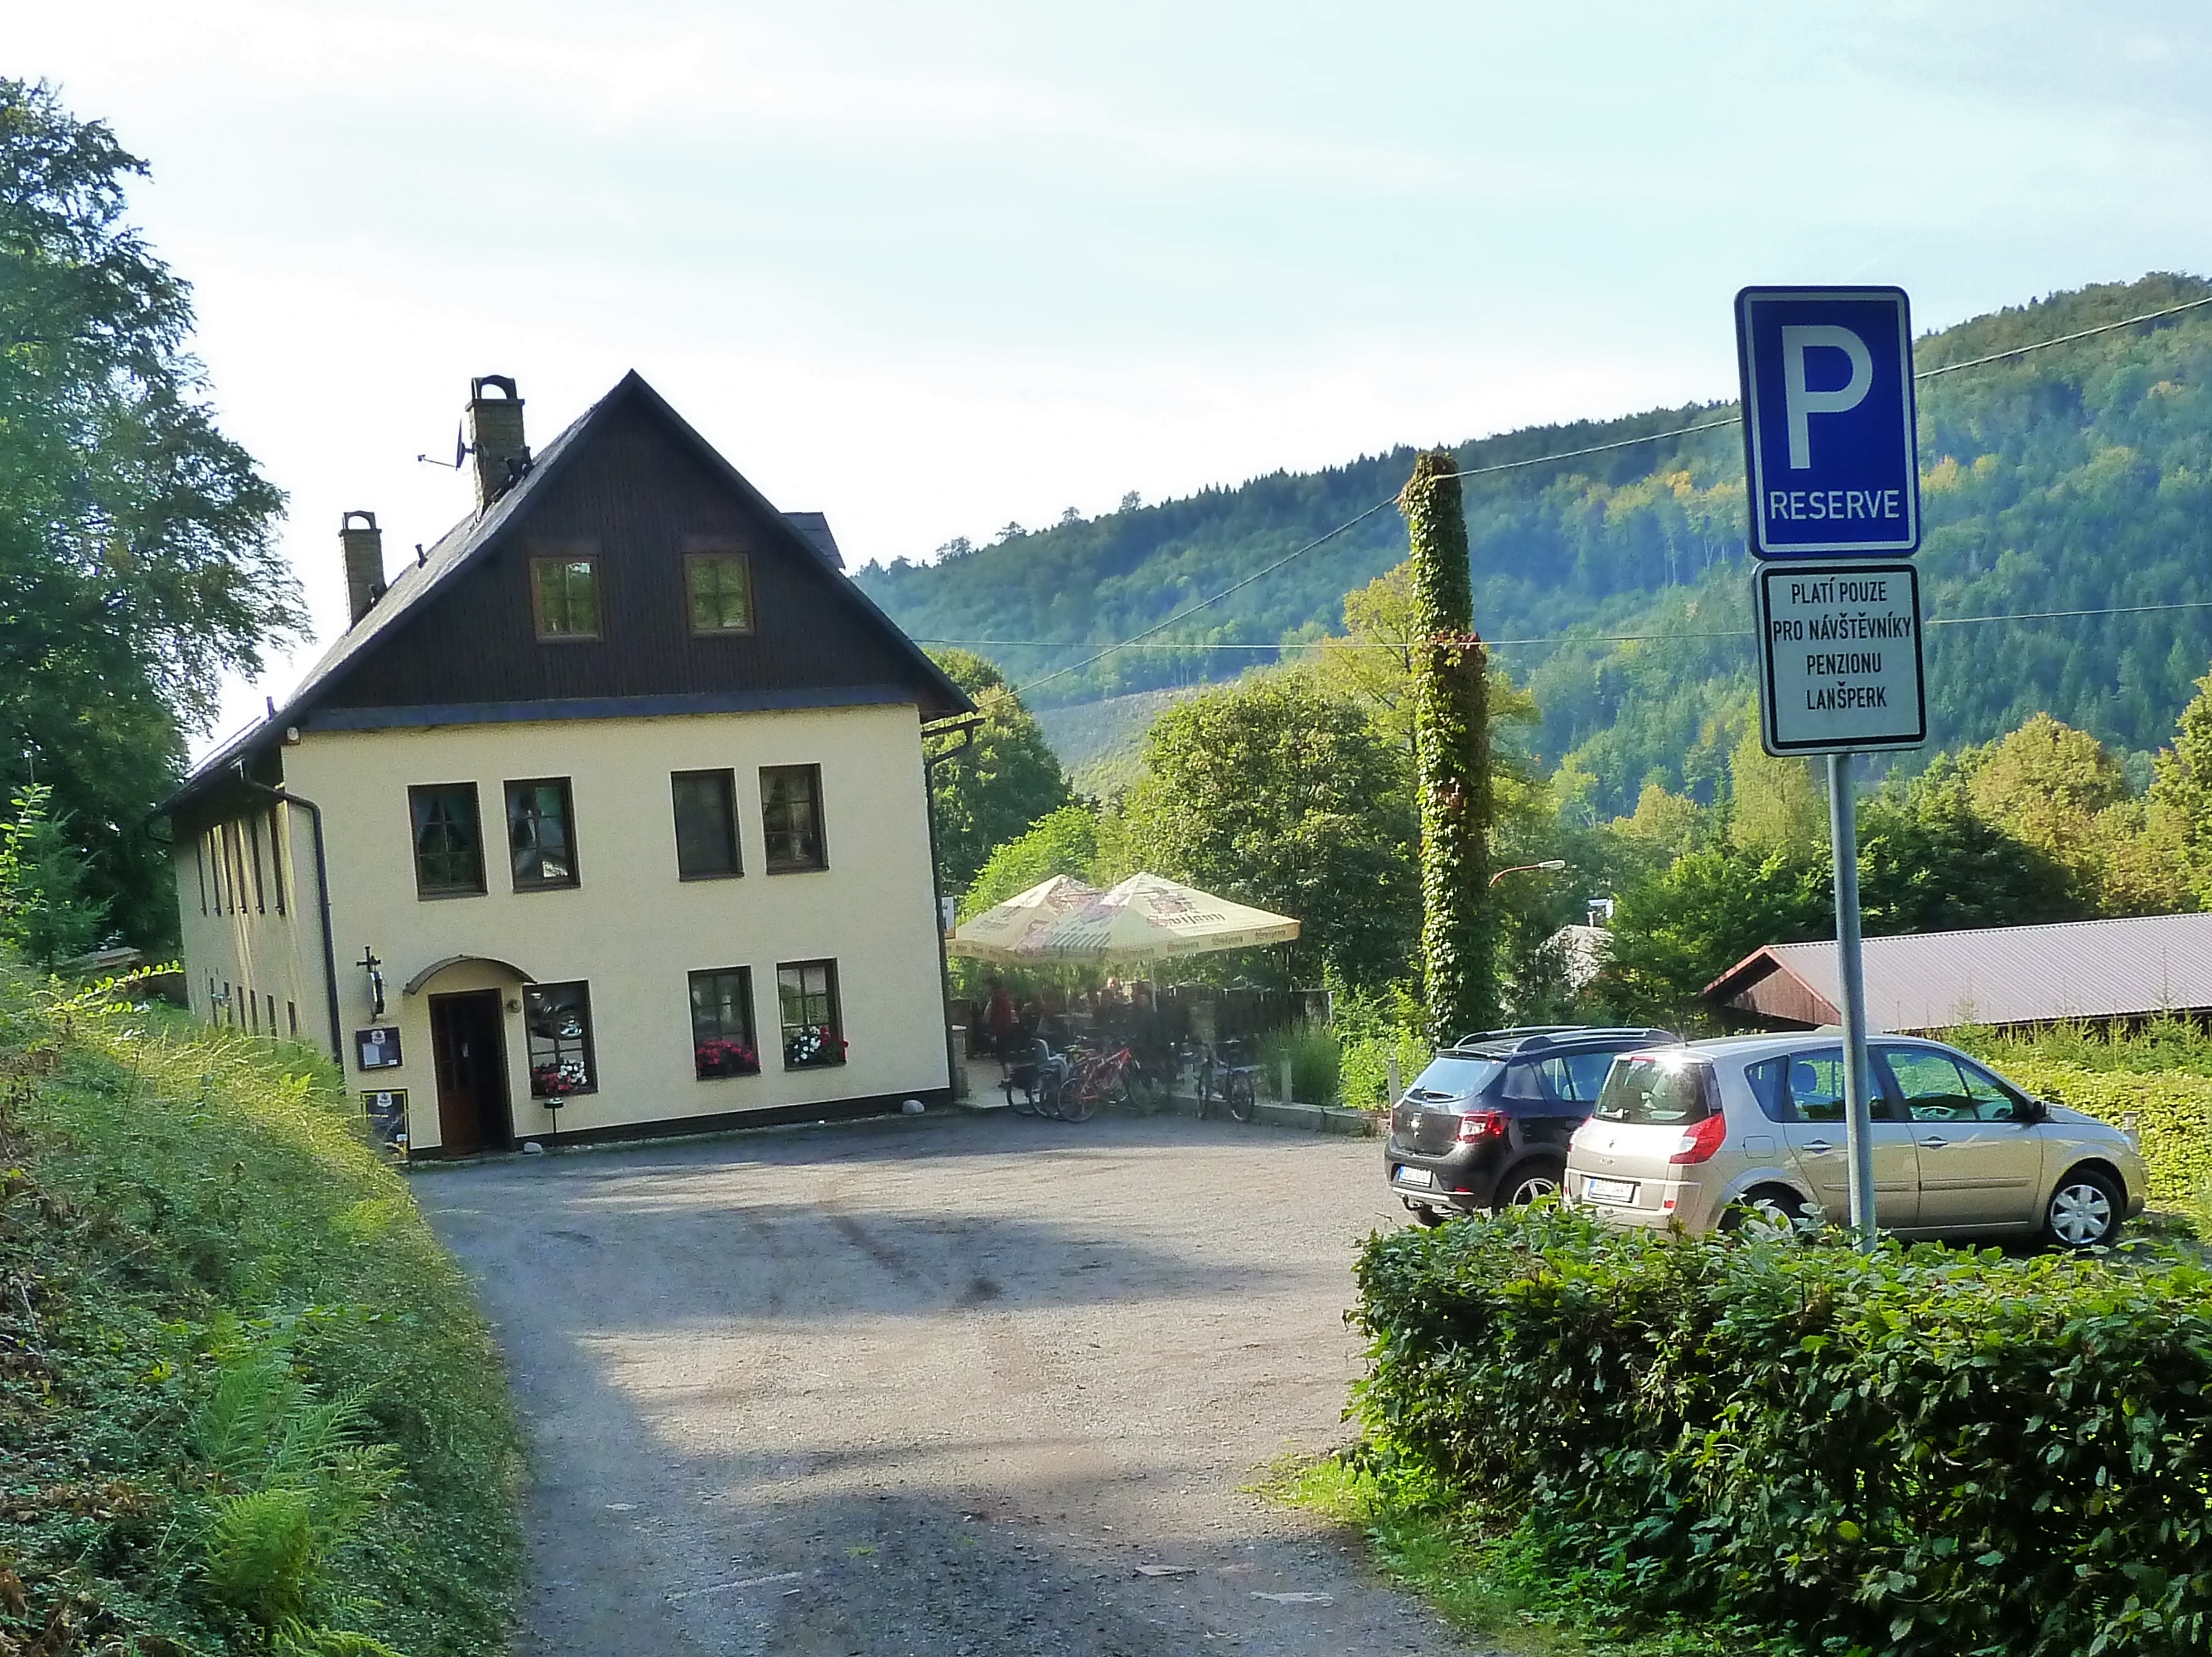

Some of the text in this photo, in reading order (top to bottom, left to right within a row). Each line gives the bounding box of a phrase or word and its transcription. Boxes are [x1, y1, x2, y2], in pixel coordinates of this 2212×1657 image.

[1781, 325, 1873, 469] P
[1770, 489, 1900, 520] RESERVE
[1791, 577, 1887, 604] PLATÍ POUZE
[1773, 611, 1911, 642] PRO NÁVŠTĚVNÍKY
[1806, 652, 1881, 675] PENZIONU
[1807, 681, 1887, 711] LANŠPERK
